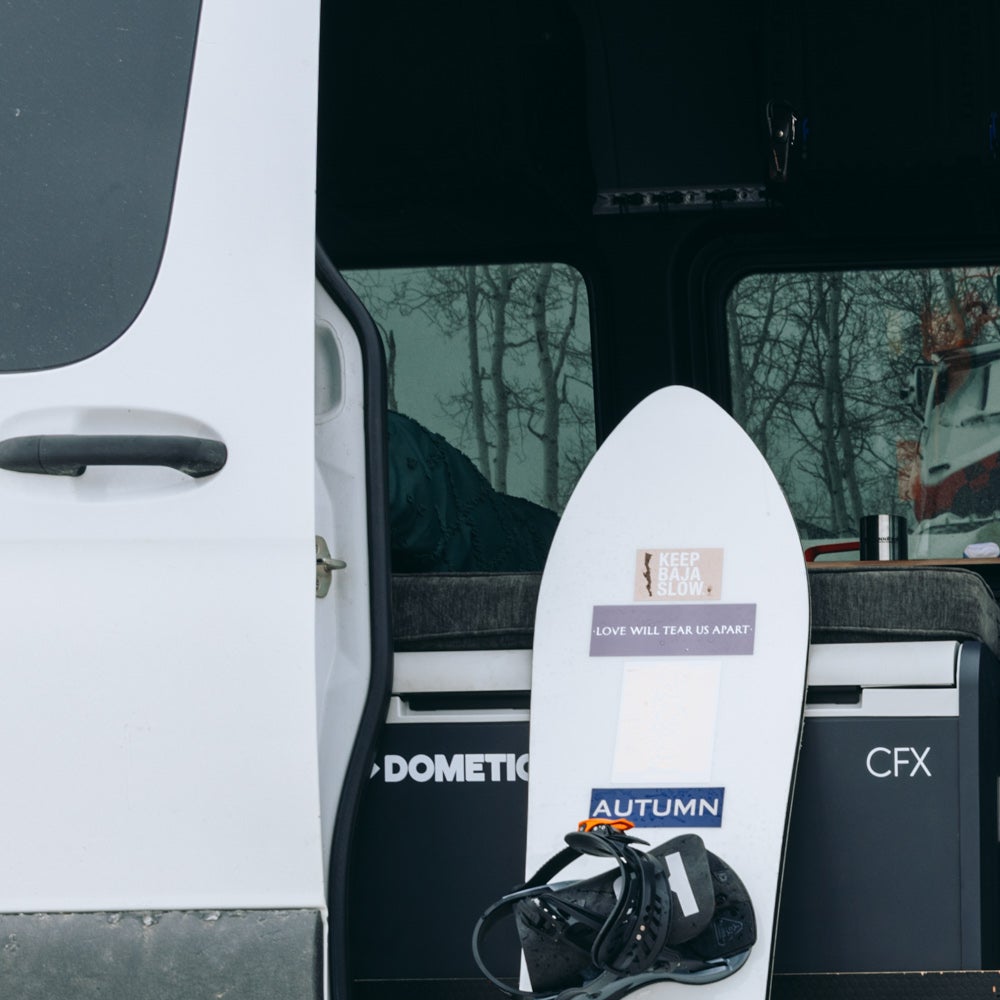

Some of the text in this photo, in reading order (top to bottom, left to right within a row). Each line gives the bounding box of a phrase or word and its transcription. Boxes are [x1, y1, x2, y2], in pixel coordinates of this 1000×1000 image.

[659, 552, 700, 567] KEEP
[658, 566, 701, 581] BAJA
[596, 624, 750, 636] LOVE WILL TEAR US APART
[866, 747, 932, 778] CFX
[592, 798, 719, 817] AUTUMN
